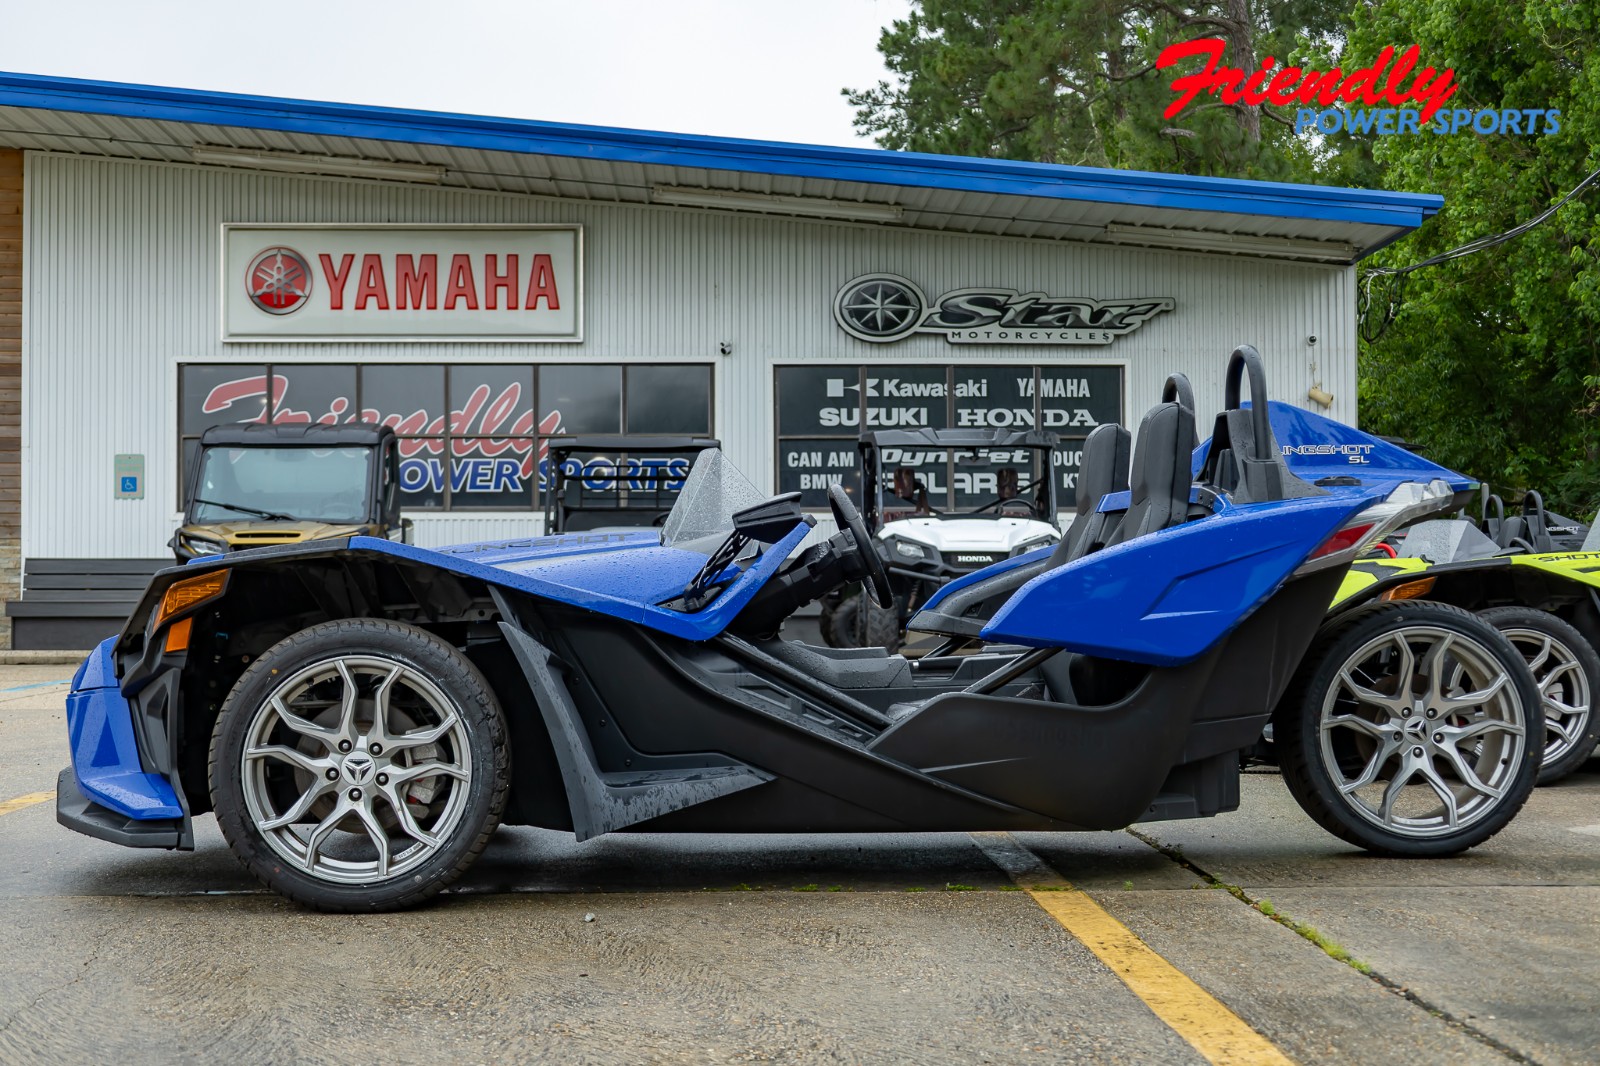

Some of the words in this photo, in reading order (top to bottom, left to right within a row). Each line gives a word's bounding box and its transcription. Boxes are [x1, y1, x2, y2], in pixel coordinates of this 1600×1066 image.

[318, 253, 560, 311] YAMAHA
[951, 331, 1110, 342] MOTORCYCLES
[1016, 378, 1091, 398] YAMAHA
[819, 407, 928, 427] SUZUKI
[957, 407, 1099, 427] HONDA
[1281, 444, 1375, 456] INGSHOT
[787, 451, 823, 468] CAN
[827, 451, 855, 468] AM
[1348, 455, 1370, 464] SL
[399, 457, 524, 493] OWER
[800, 473, 843, 490] BMW
